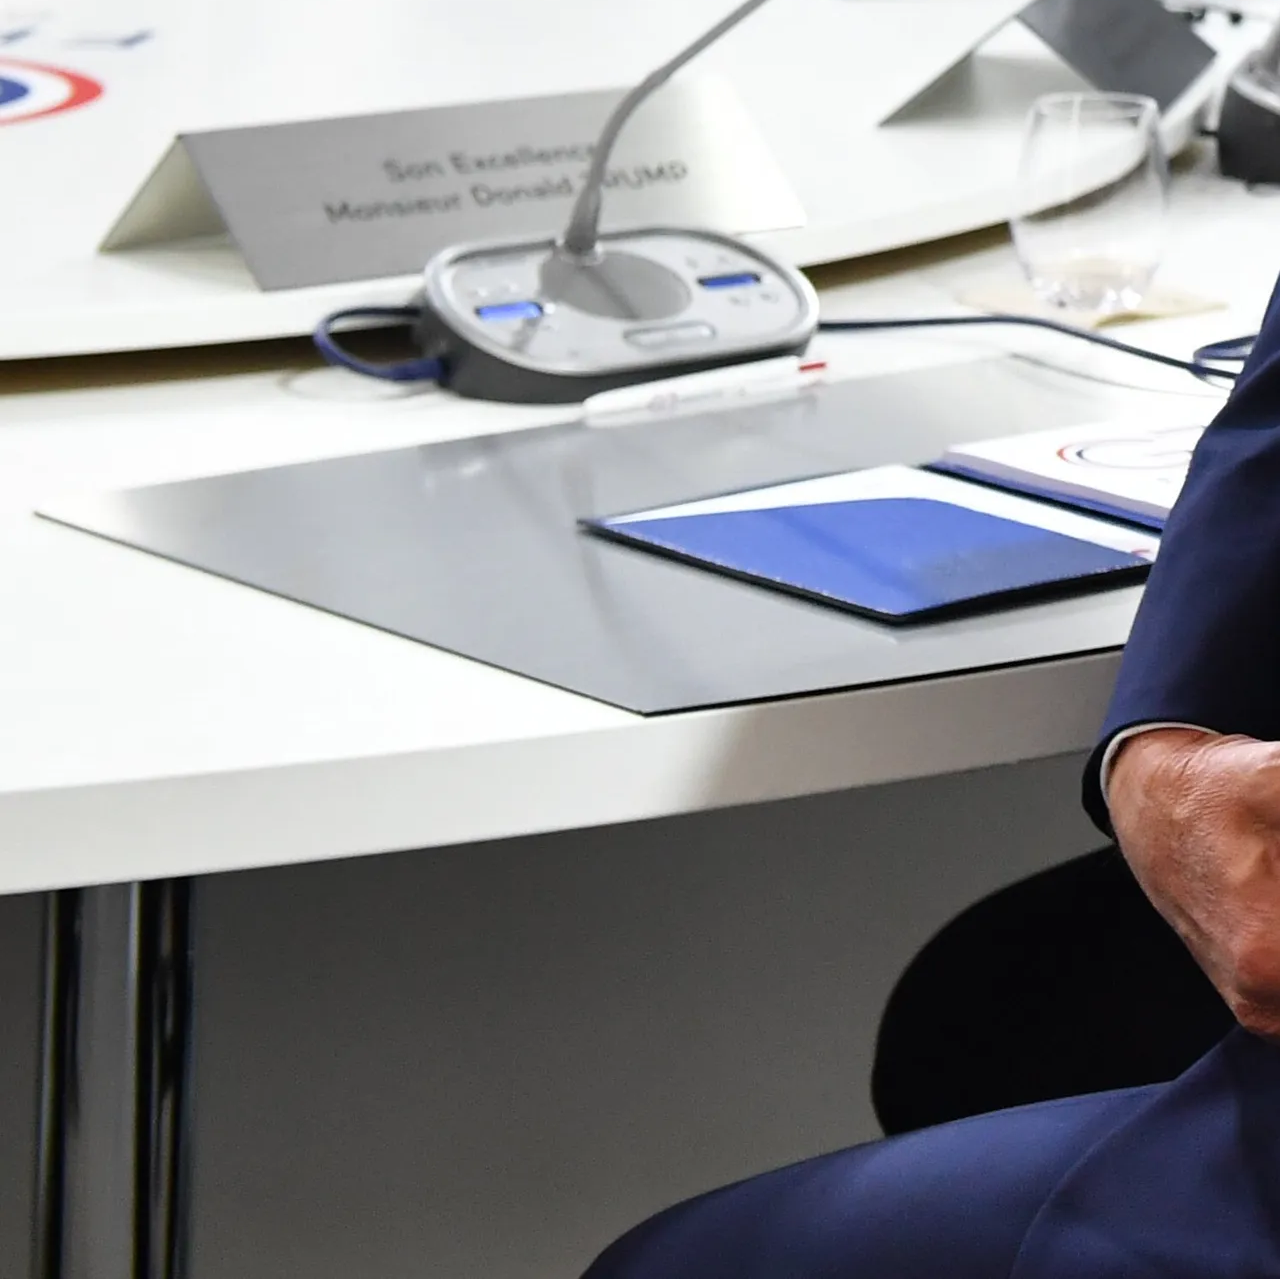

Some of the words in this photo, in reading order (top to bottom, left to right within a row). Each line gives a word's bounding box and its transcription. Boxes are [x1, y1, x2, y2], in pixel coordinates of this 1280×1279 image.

[383, 158, 444, 184] Son
[322, 193, 462, 224] Monsieur
[470, 176, 575, 207] Donald
